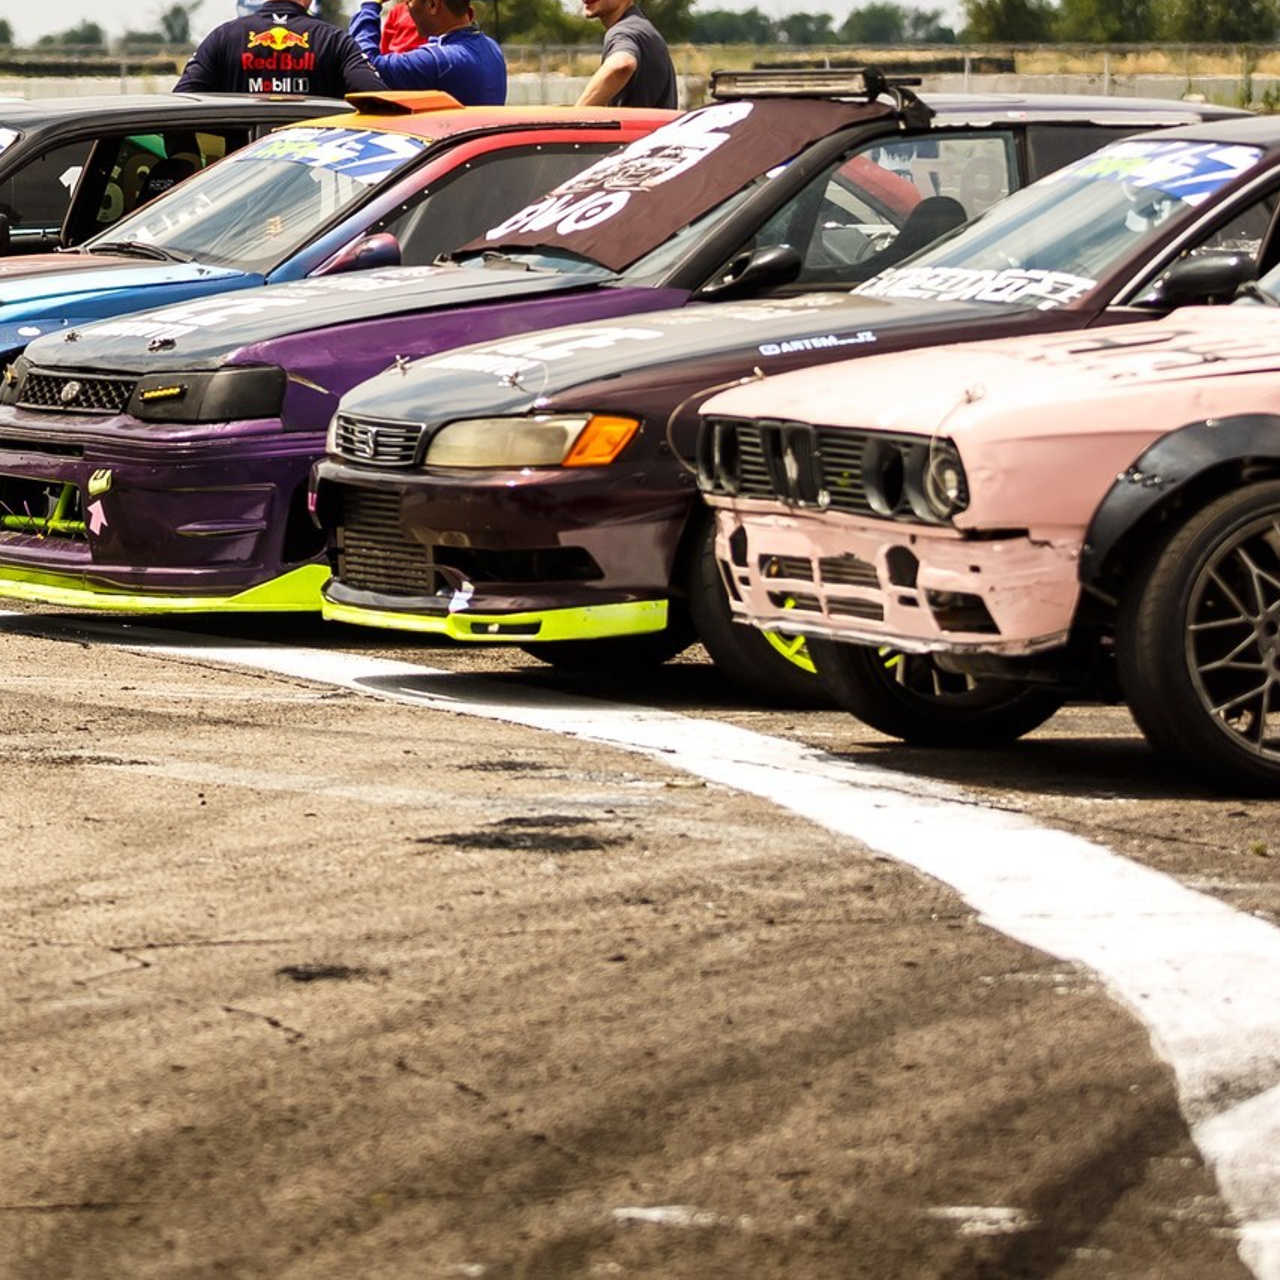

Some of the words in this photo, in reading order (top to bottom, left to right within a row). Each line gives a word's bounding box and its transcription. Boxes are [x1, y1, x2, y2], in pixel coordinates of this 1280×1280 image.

[242, 51, 277, 71] Red
[281, 51, 315, 71] Bull
[248, 77, 291, 92] Mobil
